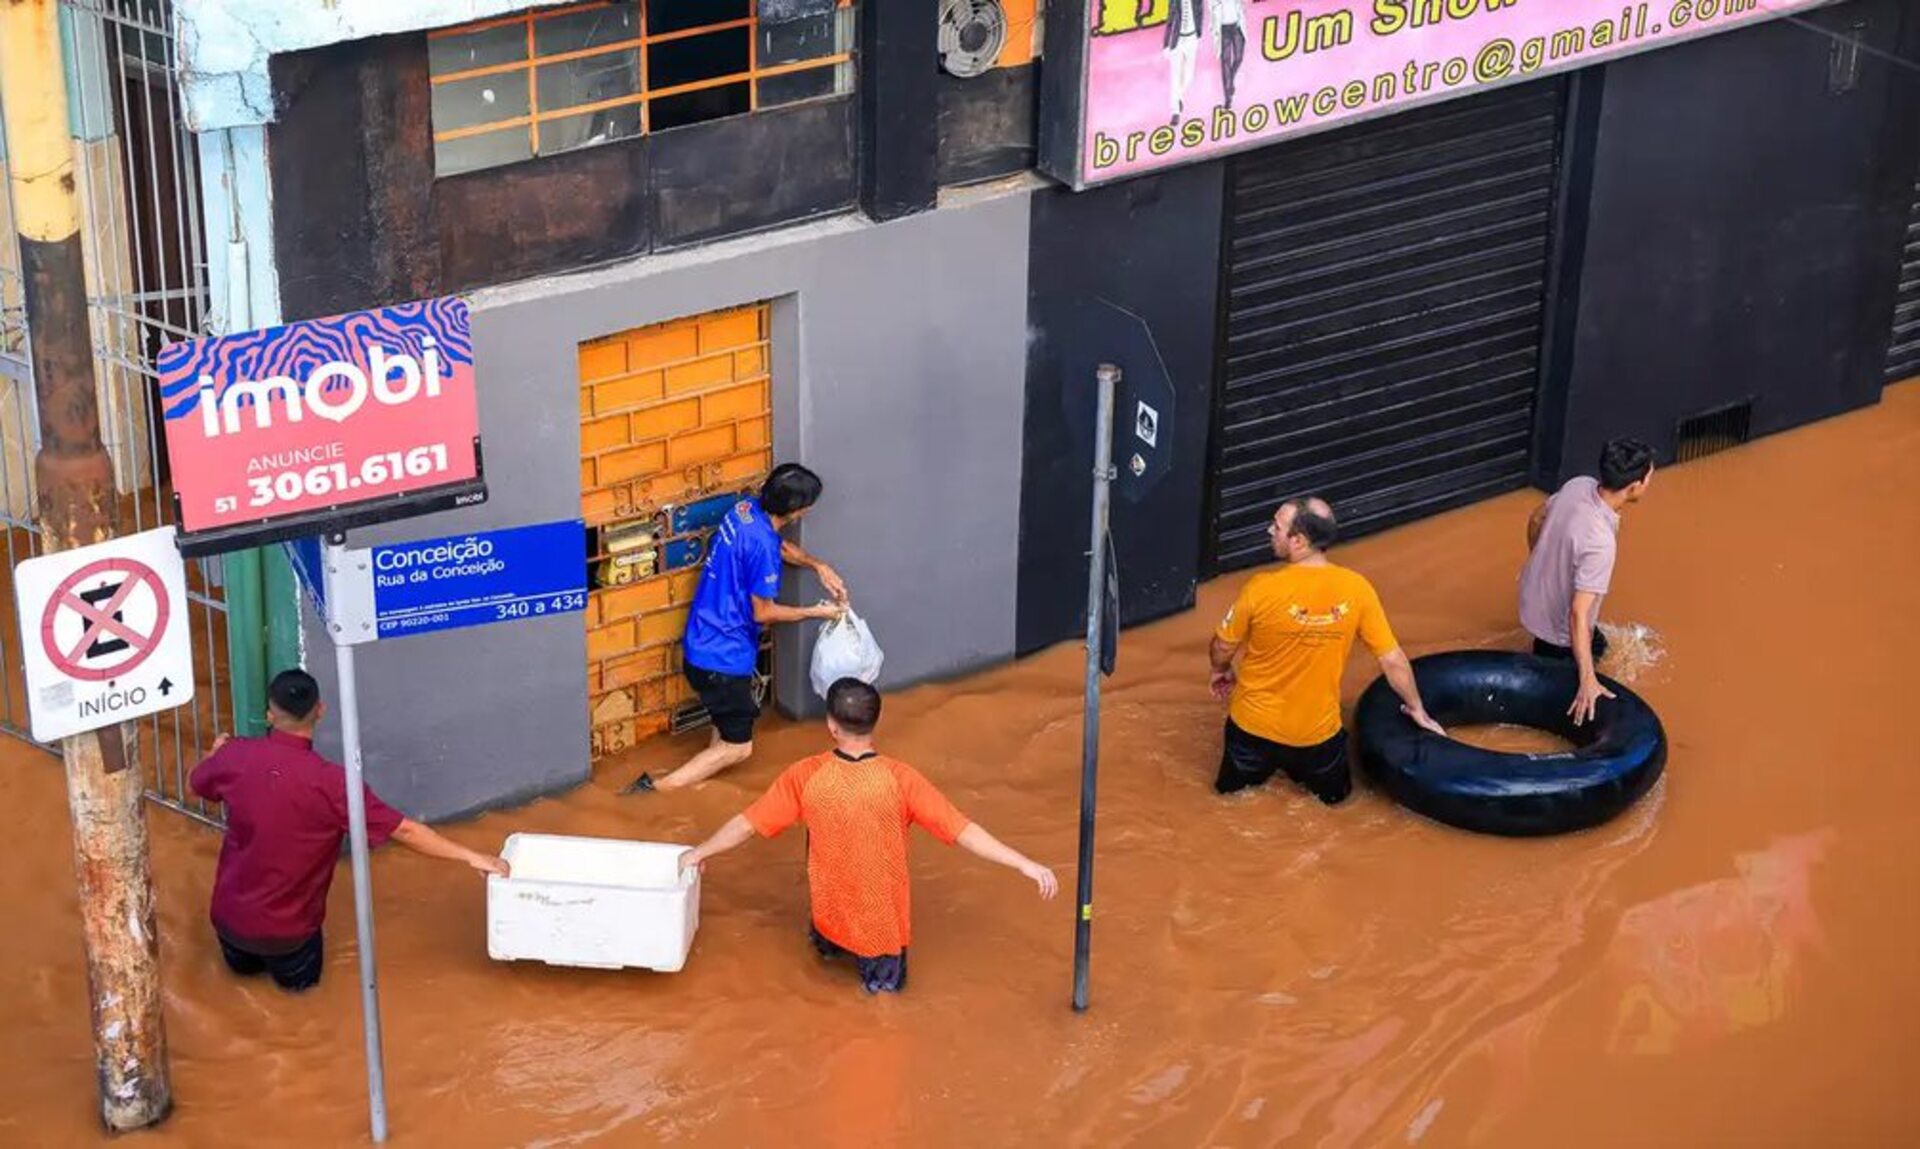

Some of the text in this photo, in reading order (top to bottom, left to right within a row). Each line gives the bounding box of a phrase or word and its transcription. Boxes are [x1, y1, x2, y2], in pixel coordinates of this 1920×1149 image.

[1261, 0, 1518, 62] Um Sho
[198, 337, 440, 437] imobi
[247, 442, 344, 474] ANUNCIE
[214, 444, 448, 512] 51 3061.6161
[376, 537, 493, 571] Conceição
[377, 560, 505, 588] Rua da Conceição
[496, 601, 529, 619] 340
[535, 603, 545, 613] a
[551, 593, 584, 611] 434
